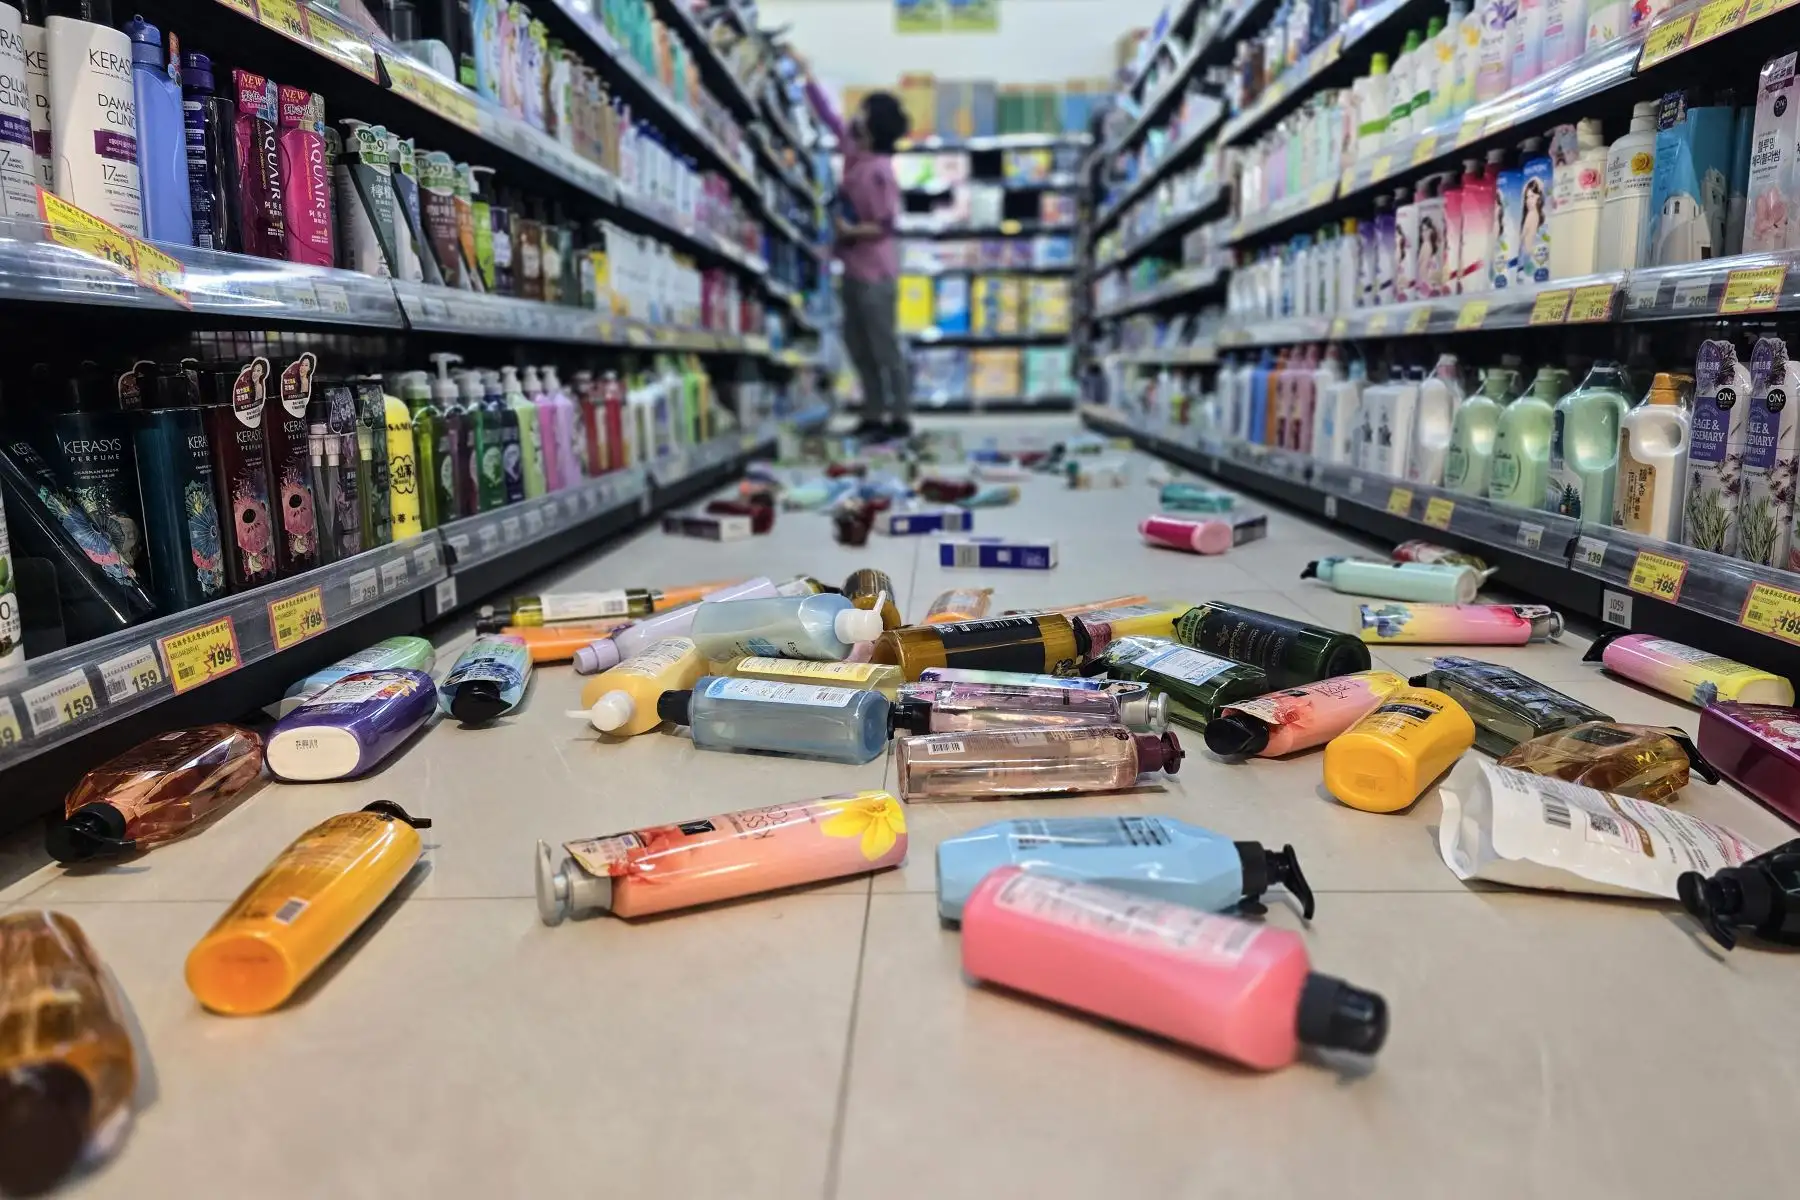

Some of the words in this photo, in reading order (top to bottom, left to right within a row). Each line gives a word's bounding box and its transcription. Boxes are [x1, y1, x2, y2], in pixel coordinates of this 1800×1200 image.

[241, 73, 264, 87] NEW
[282, 88, 306, 101] NEW
[264, 121, 281, 200] AQUAIR
[102, 163, 117, 181] 17
[310, 135, 327, 209] AQUAIR
[104, 246, 133, 270] 199
[63, 438, 122, 454] KERASYS
[70, 453, 121, 463] PERFUME
[1587, 551, 1602, 565] 139
[1656, 578, 1675, 594] 199
[1609, 599, 1625, 612] 1059
[305, 612, 322, 630] 199
[211, 647, 233, 669] 199
[131, 669, 158, 692] 159
[63, 694, 94, 720] 159
